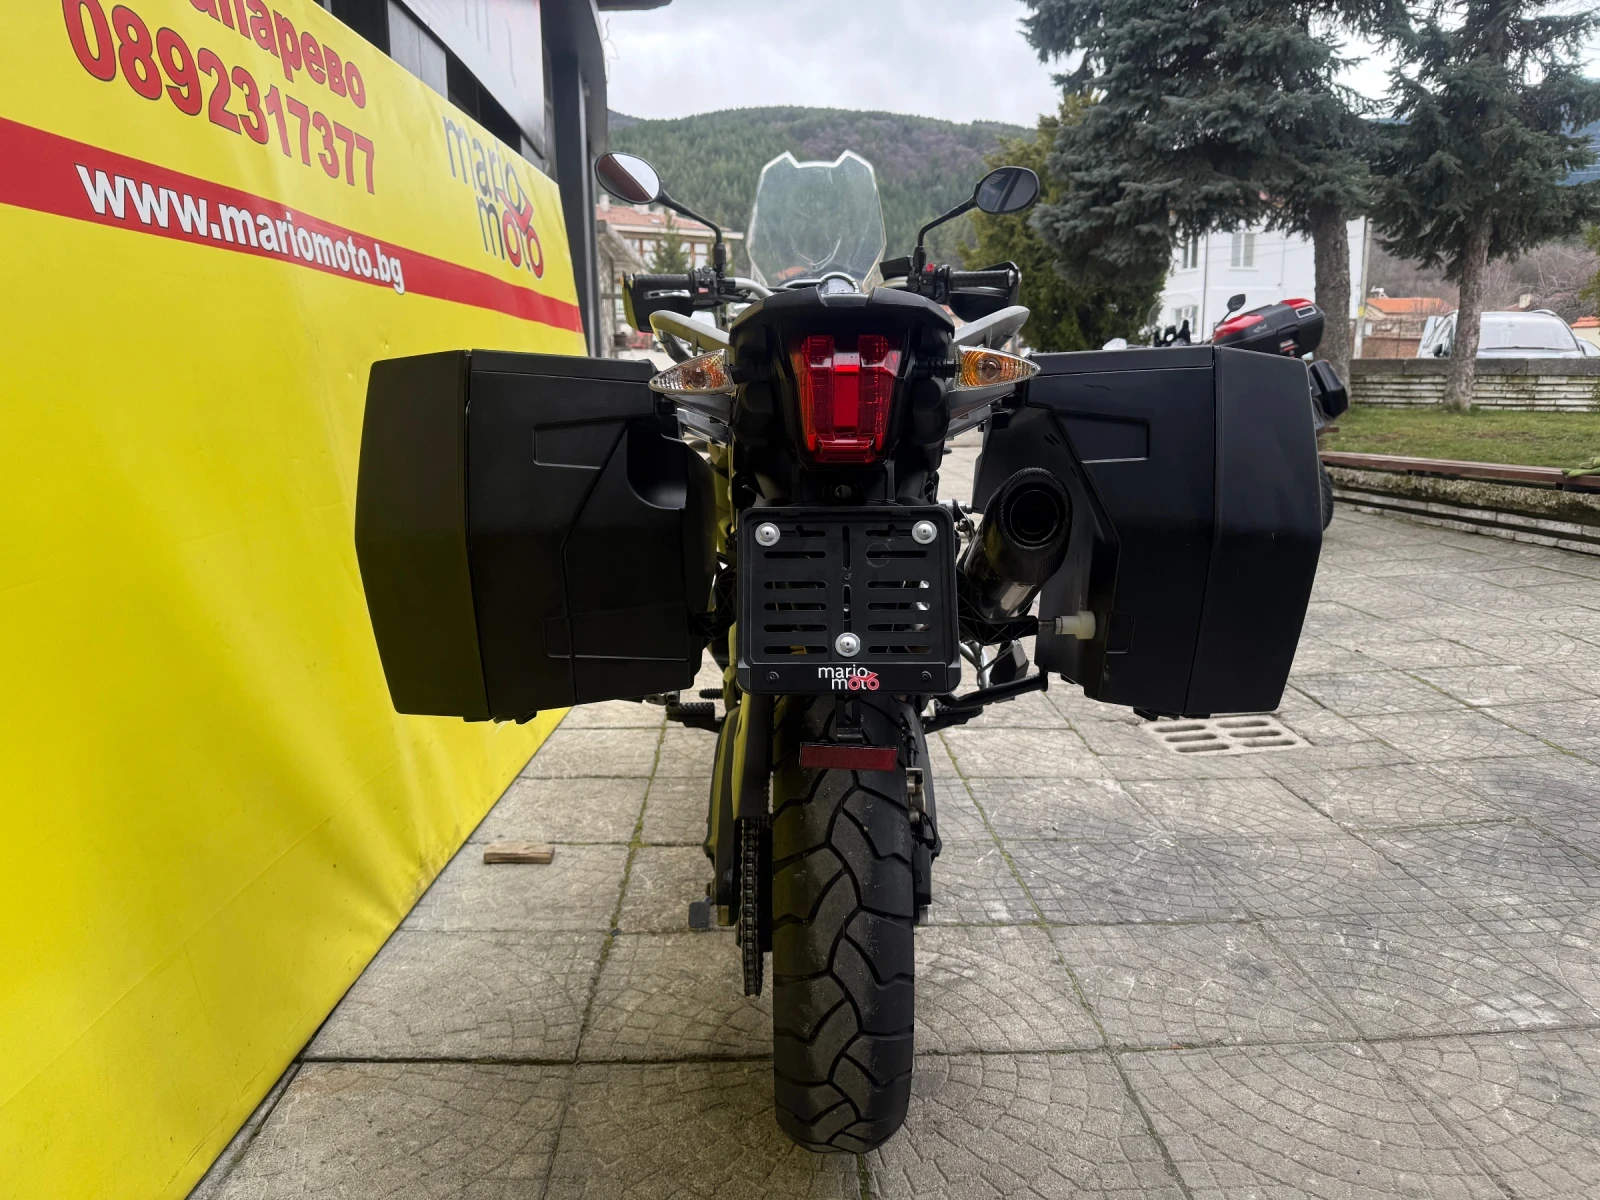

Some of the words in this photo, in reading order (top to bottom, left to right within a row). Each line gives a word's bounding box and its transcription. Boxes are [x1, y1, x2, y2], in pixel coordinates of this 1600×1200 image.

[61, 0, 375, 195] 0892317377
[190, 0, 366, 109] арево
[442, 116, 523, 216] mario
[74, 163, 405, 295] www.mariomoto.bg
[476, 196, 544, 279] moto
[818, 664, 868, 678] mario
[832, 679, 879, 690] moto
